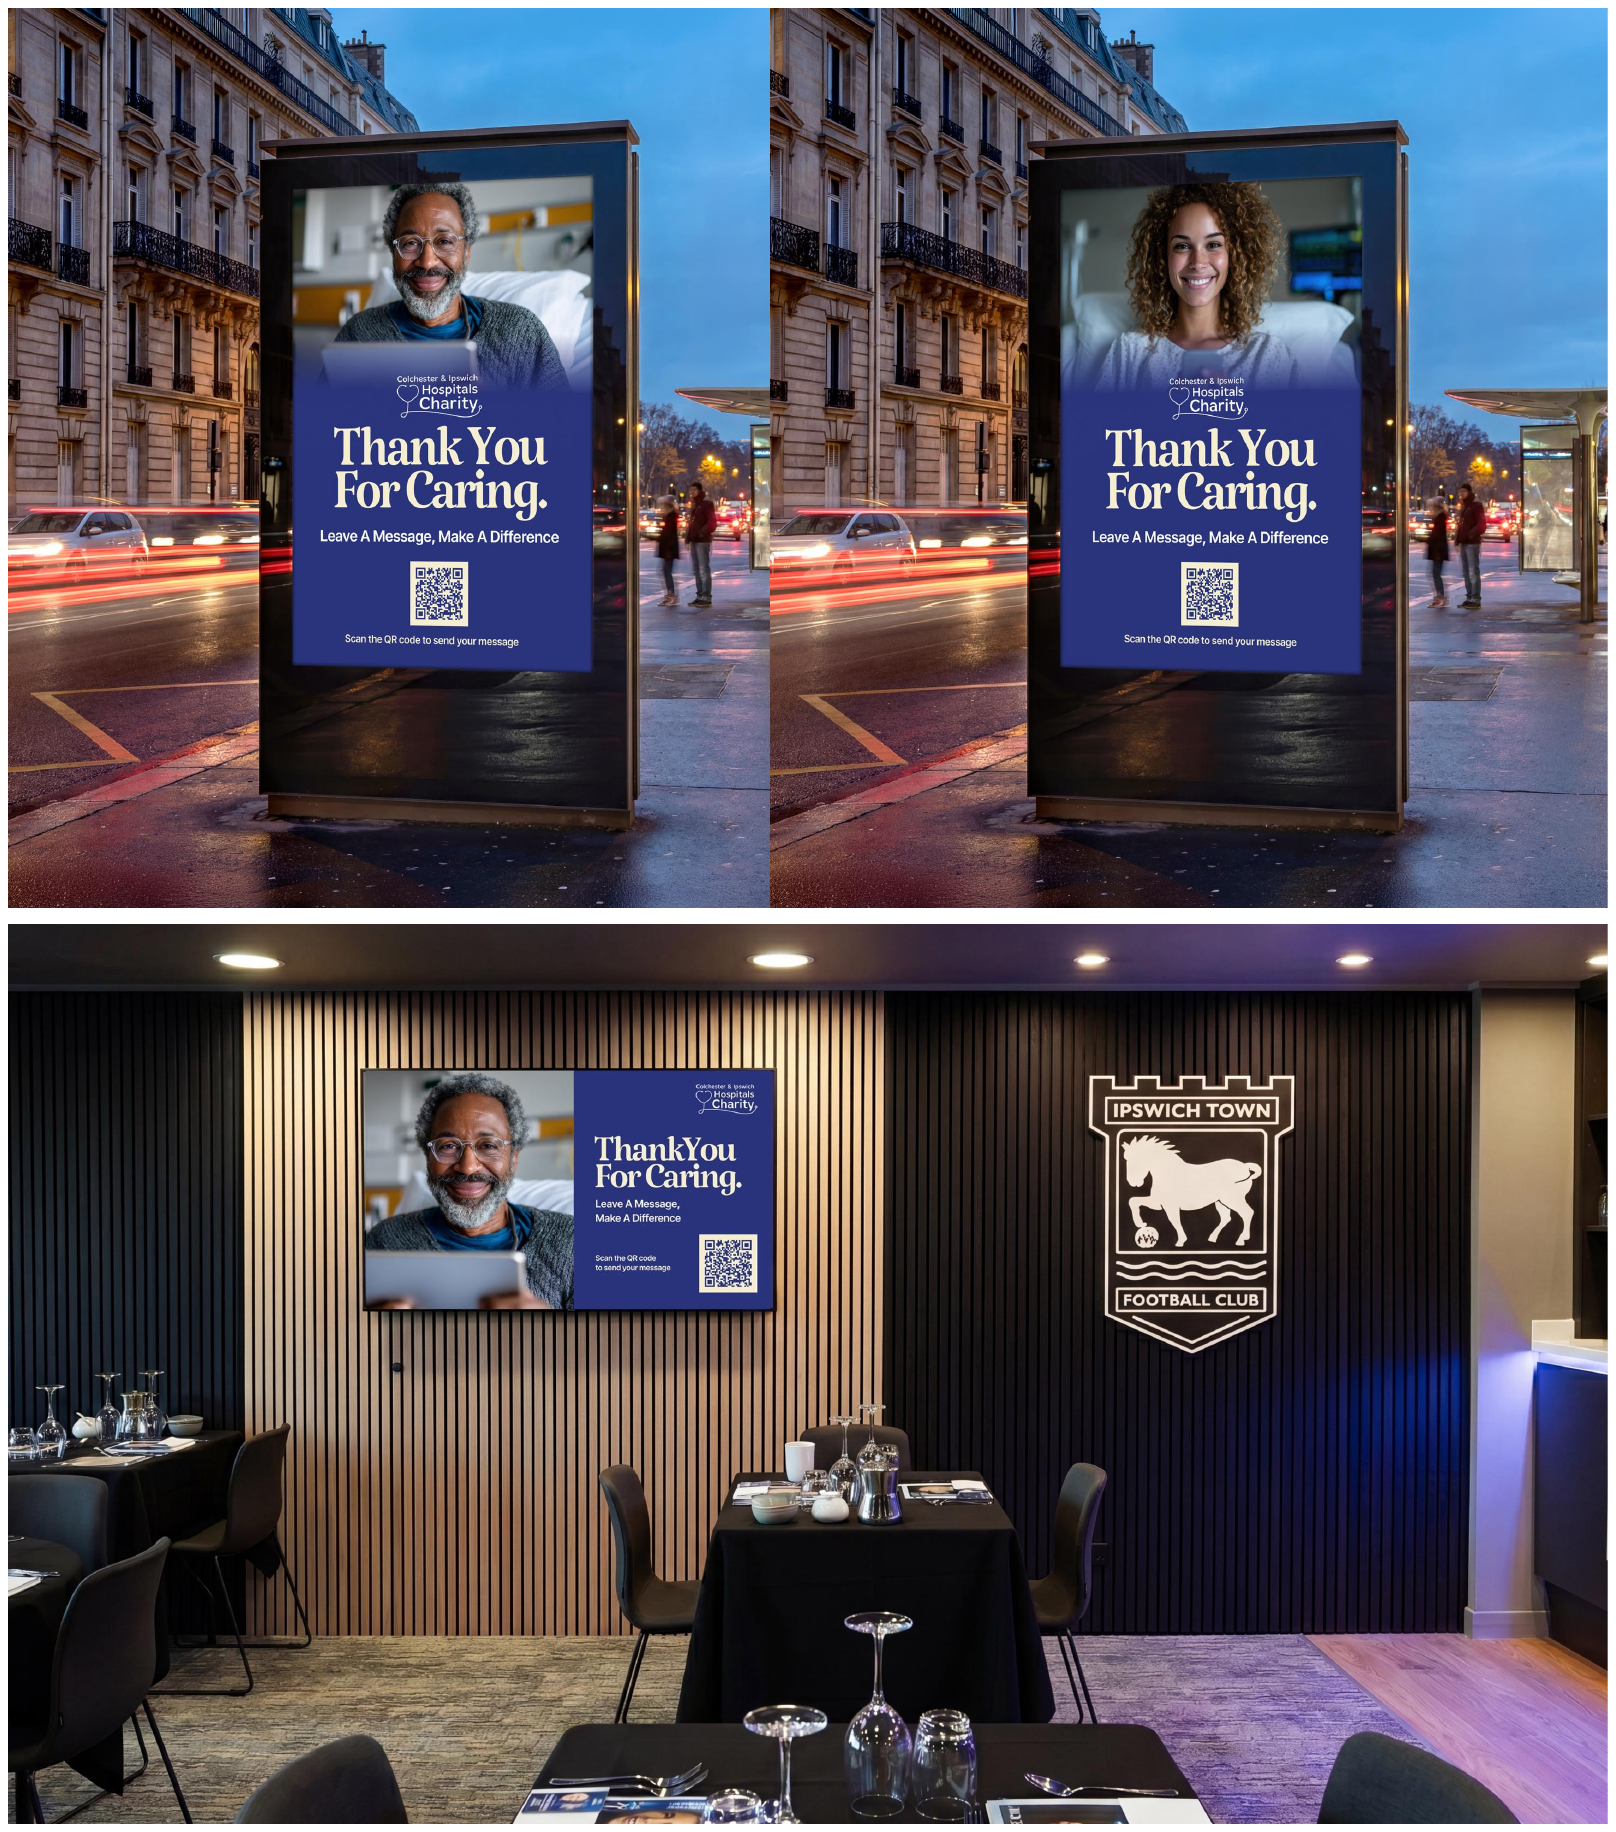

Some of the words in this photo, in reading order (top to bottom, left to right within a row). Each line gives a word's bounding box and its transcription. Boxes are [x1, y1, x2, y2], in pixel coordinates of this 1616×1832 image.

[448, 373, 478, 383] Ipswich
[1169, 377, 1207, 385] Colchester
[1217, 376, 1244, 385] Ipswich
[422, 383, 477, 396] Hospitals
[1192, 386, 1243, 398] Hospitals
[419, 396, 478, 413] Charity
[1189, 398, 1244, 415] Charity
[333, 425, 464, 465] Thank
[466, 426, 548, 465] You
[1105, 427, 1234, 467] Thank
[1237, 428, 1317, 466] You
[334, 469, 400, 508] For
[406, 468, 547, 521] Caring.
[1105, 471, 1171, 509] For
[1177, 470, 1316, 522] Caring.
[320, 529, 357, 542] Leave
[360, 529, 370, 542] A
[373, 529, 435, 545] Message,
[438, 530, 474, 542] Make
[477, 530, 487, 542] A
[490, 529, 559, 543] Difference
[1092, 530, 1129, 542] Leave
[1131, 530, 1141, 542] A
[1144, 530, 1205, 546] Message,
[1209, 530, 1244, 543] Make
[1247, 531, 1257, 543] A
[1260, 530, 1328, 544] Difference
[345, 633, 366, 642] Scan
[367, 634, 382, 643] the
[383, 634, 397, 644] QR
[398, 635, 420, 644] code
[422, 636, 431, 644] to
[433, 636, 454, 644] send
[456, 638, 476, 647] your
[478, 638, 519, 648] message
[1124, 634, 1145, 643] Scan
[1147, 635, 1161, 643] the
[1163, 634, 1176, 644] QR
[1177, 635, 1199, 644] code
[1200, 636, 1209, 644] to
[1211, 636, 1233, 645] send
[1235, 638, 1255, 647] your
[1256, 639, 1297, 648] message
[713, 1090, 754, 1099] Hospitals
[711, 1099, 755, 1111] Charity
[1113, 1103, 1200, 1117] IPSWICH
[1205, 1103, 1270, 1118] TOWN
[595, 1163, 641, 1188] For
[645, 1162, 742, 1195] Caring.
[595, 1199, 623, 1208] Leave
[625, 1199, 632, 1207] A
[634, 1199, 679, 1210] Message,
[595, 1213, 621, 1222] Make
[622, 1213, 630, 1222] A
[632, 1213, 681, 1222] Difference
[1123, 1293, 1210, 1306] FOOTBALL
[1215, 1293, 1258, 1306] CLUB
